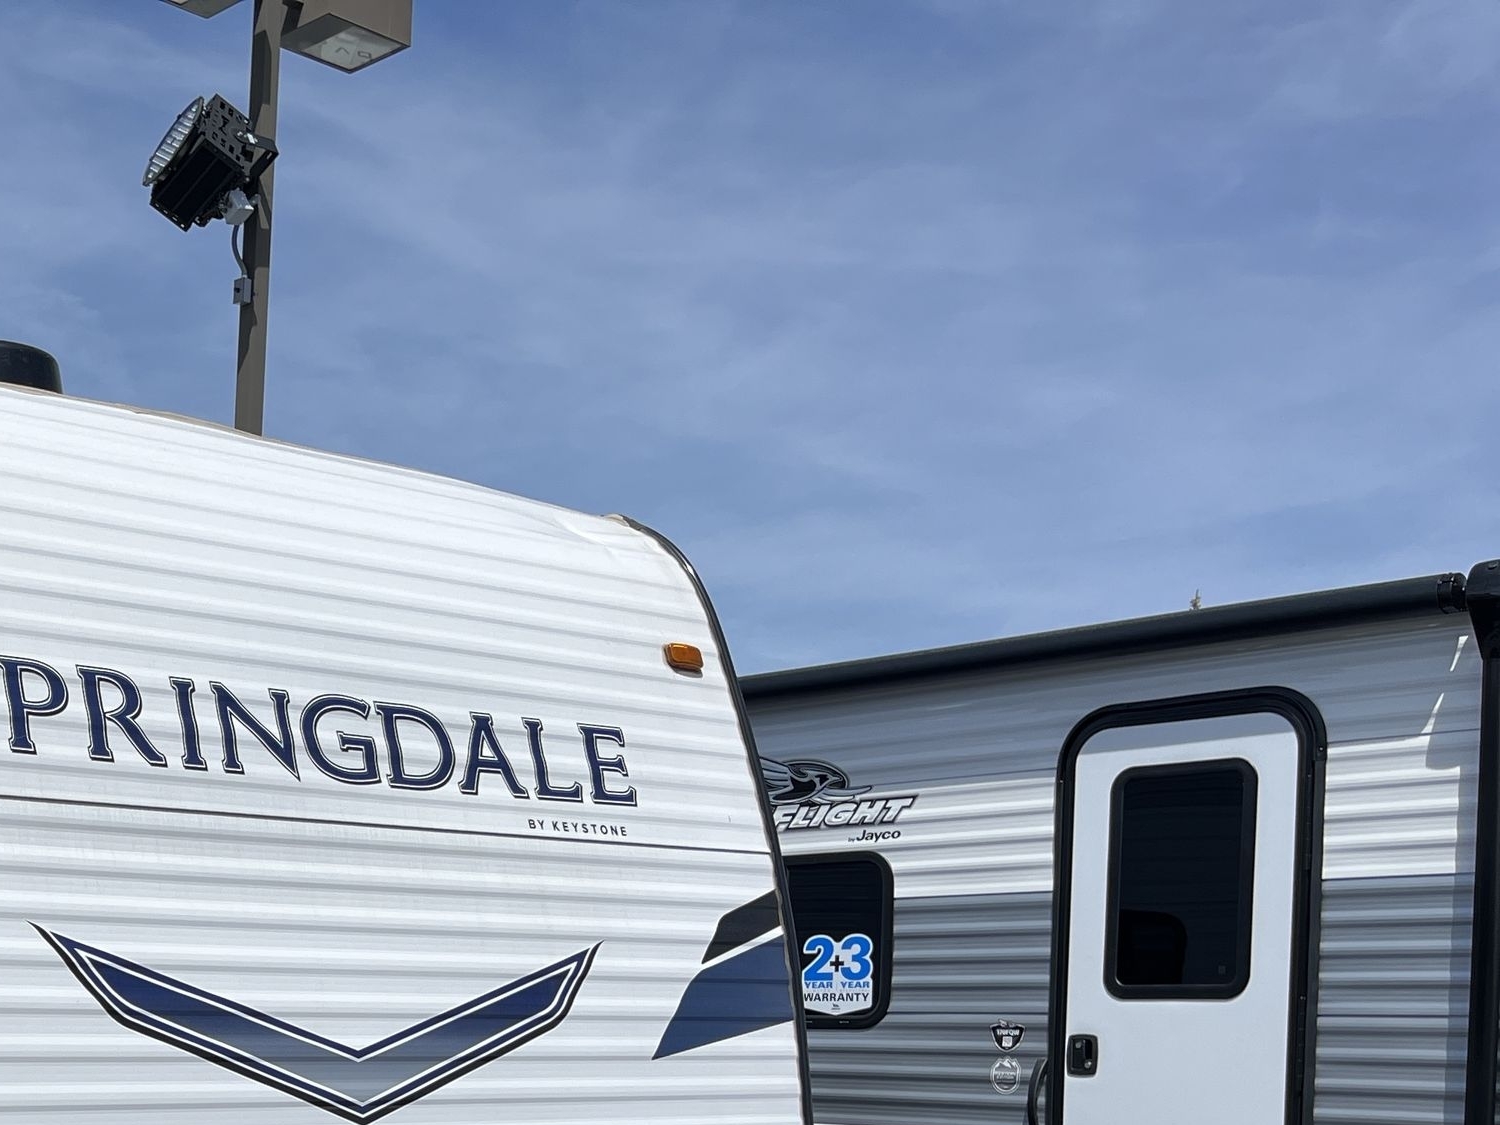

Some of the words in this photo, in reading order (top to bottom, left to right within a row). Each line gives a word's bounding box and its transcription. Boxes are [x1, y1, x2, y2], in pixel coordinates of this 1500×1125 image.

[772, 796, 919, 831] FLIGHT
[528, 819, 545, 830] BY
[552, 821, 627, 836] KEYSTONE
[856, 829, 901, 843] Jayco
[804, 981, 833, 989] YEAR
[840, 981, 870, 989] YEAR
[804, 992, 870, 1002] WARRANTY
